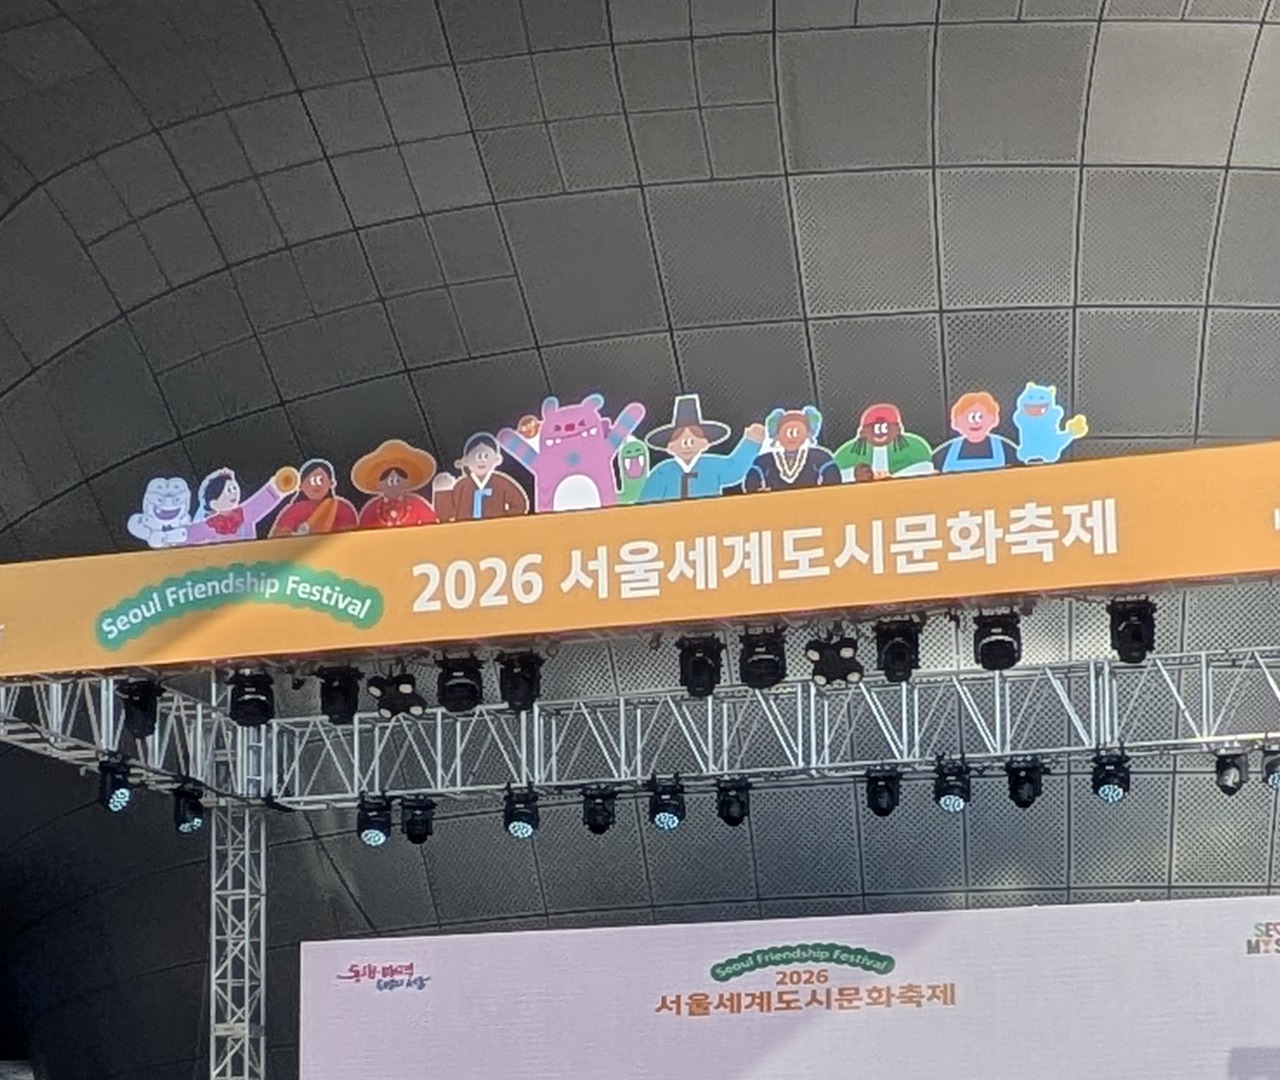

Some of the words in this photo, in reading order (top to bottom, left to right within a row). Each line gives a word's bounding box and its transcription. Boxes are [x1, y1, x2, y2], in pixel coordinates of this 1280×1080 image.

[412, 553, 544, 612] 2026
[560, 498, 1118, 600] 서울세계도시문화축제
[101, 592, 162, 640] Seoul
[165, 570, 280, 607] Friendship
[285, 574, 372, 619] Festival
[715, 956, 754, 978] Seoul
[756, 948, 830, 965] Friendship
[832, 949, 889, 971] Festival
[775, 969, 830, 986] 2026
[655, 982, 956, 1017] 서울세계도시문화축제
